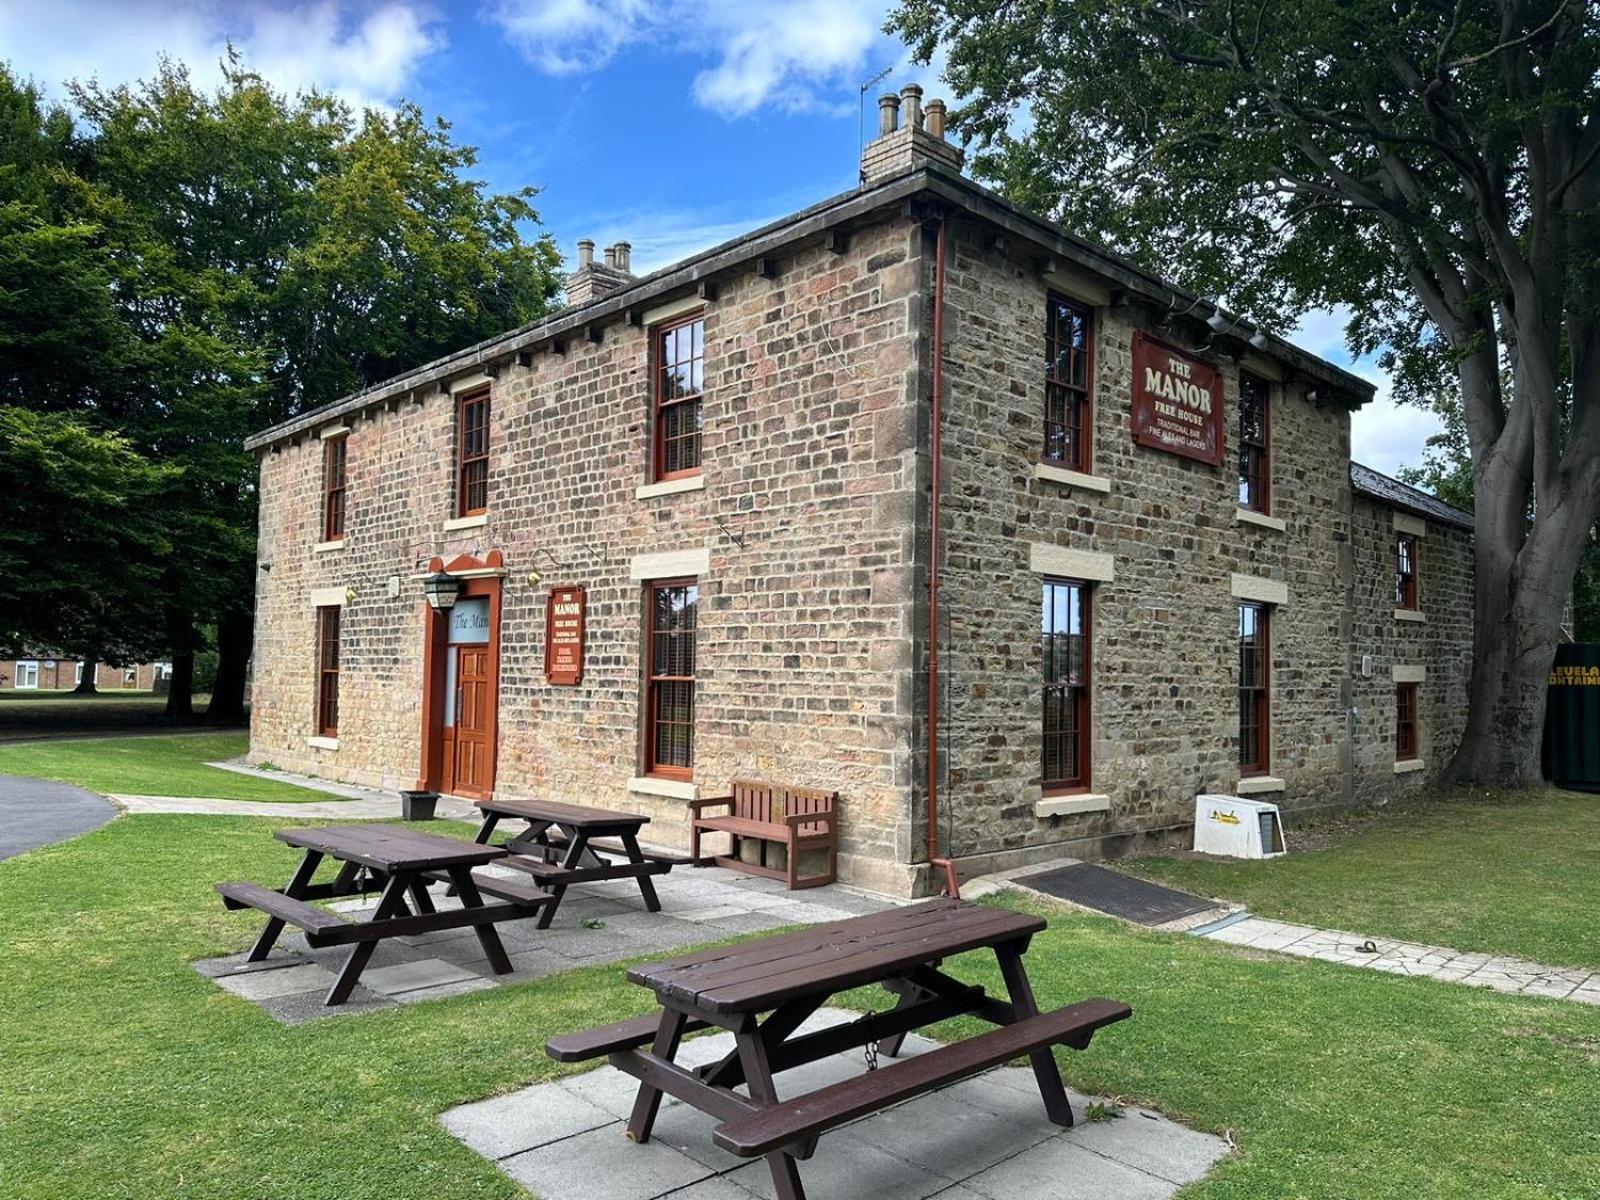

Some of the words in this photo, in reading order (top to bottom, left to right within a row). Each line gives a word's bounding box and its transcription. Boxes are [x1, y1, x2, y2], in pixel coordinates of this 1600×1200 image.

[1168, 358, 1191, 379] THE
[1145, 367, 1212, 415] MANOR
[1155, 401, 1176, 417] FREE
[1178, 408, 1203, 427] HOUSE
[1149, 426, 1161, 437] FINE
[1157, 418, 1188, 435] TRADITIONAL
[1189, 428, 1200, 439] BAR
[562, 594, 572, 602] THE
[554, 603, 580, 616] MANOR
[454, 612, 469, 630] The
